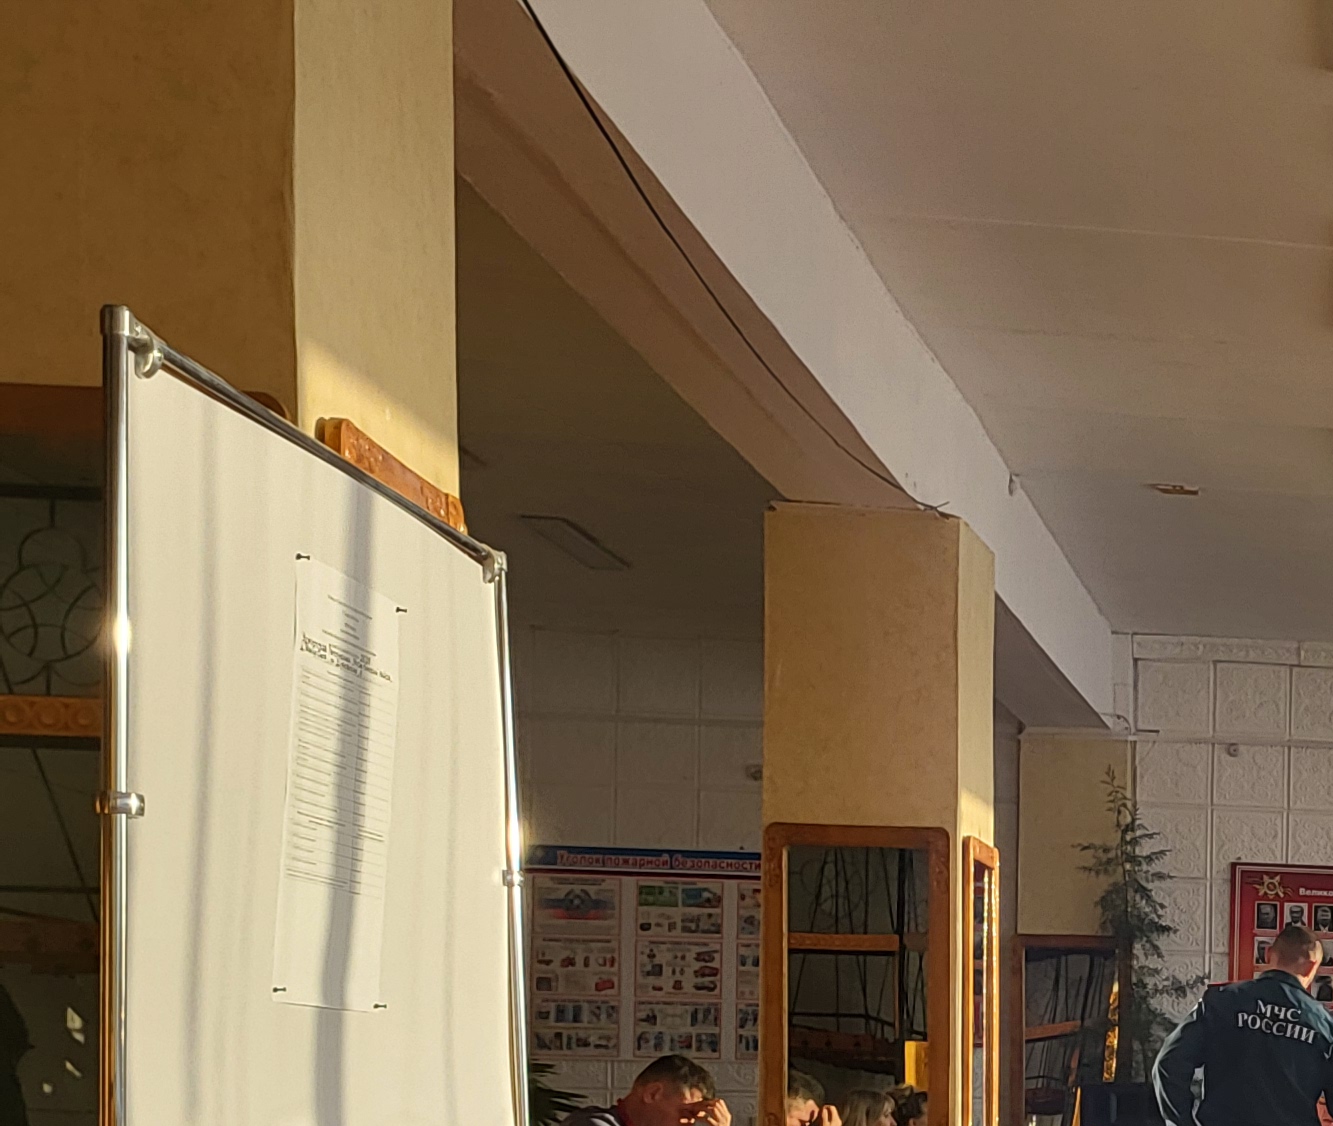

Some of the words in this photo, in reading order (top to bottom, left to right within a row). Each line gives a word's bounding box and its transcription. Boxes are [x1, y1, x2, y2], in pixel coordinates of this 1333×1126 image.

[558, 852, 600, 866] Уголок
[606, 854, 669, 869] пожарной
[672, 855, 761, 871] безопасности
[1257, 999, 1301, 1021] МЧС
[1237, 1012, 1315, 1044] РОССИИ
